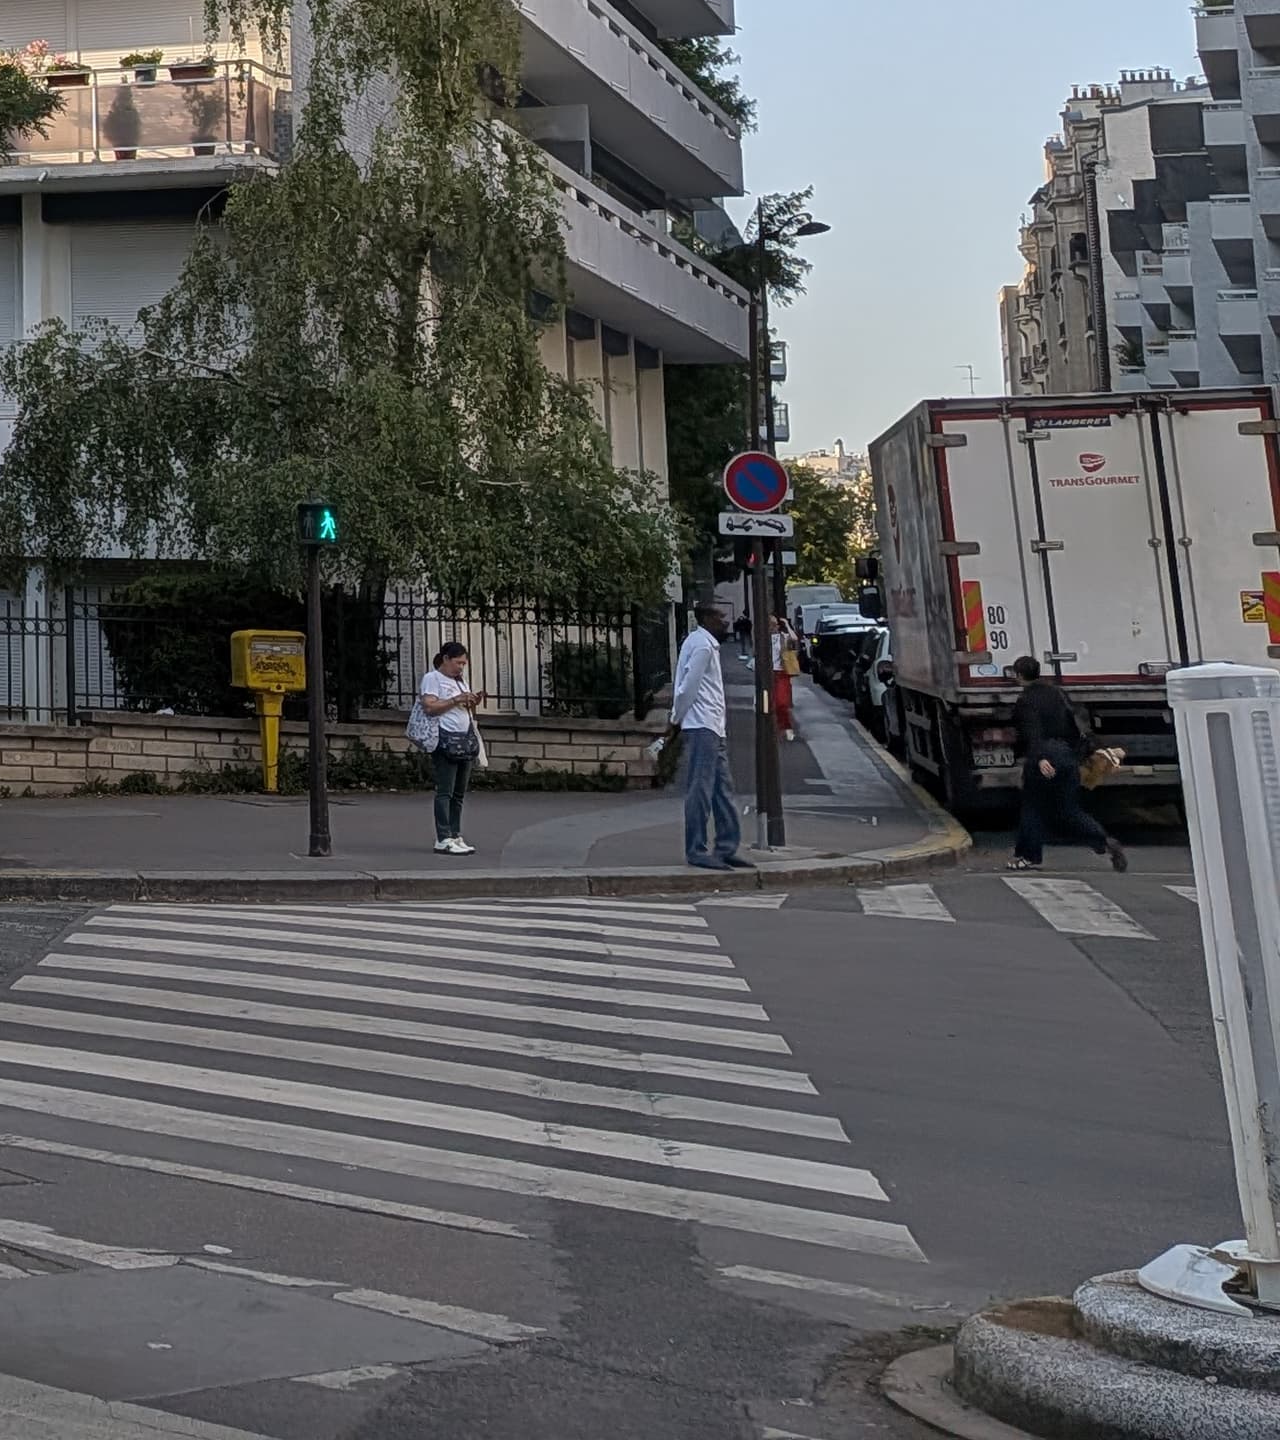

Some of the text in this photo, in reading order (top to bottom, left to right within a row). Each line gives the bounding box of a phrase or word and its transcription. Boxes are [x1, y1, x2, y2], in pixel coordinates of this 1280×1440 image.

[1048, 417, 1109, 427] LAMBERET
[987, 606, 1006, 625] 80
[990, 630, 1008, 650] 90
